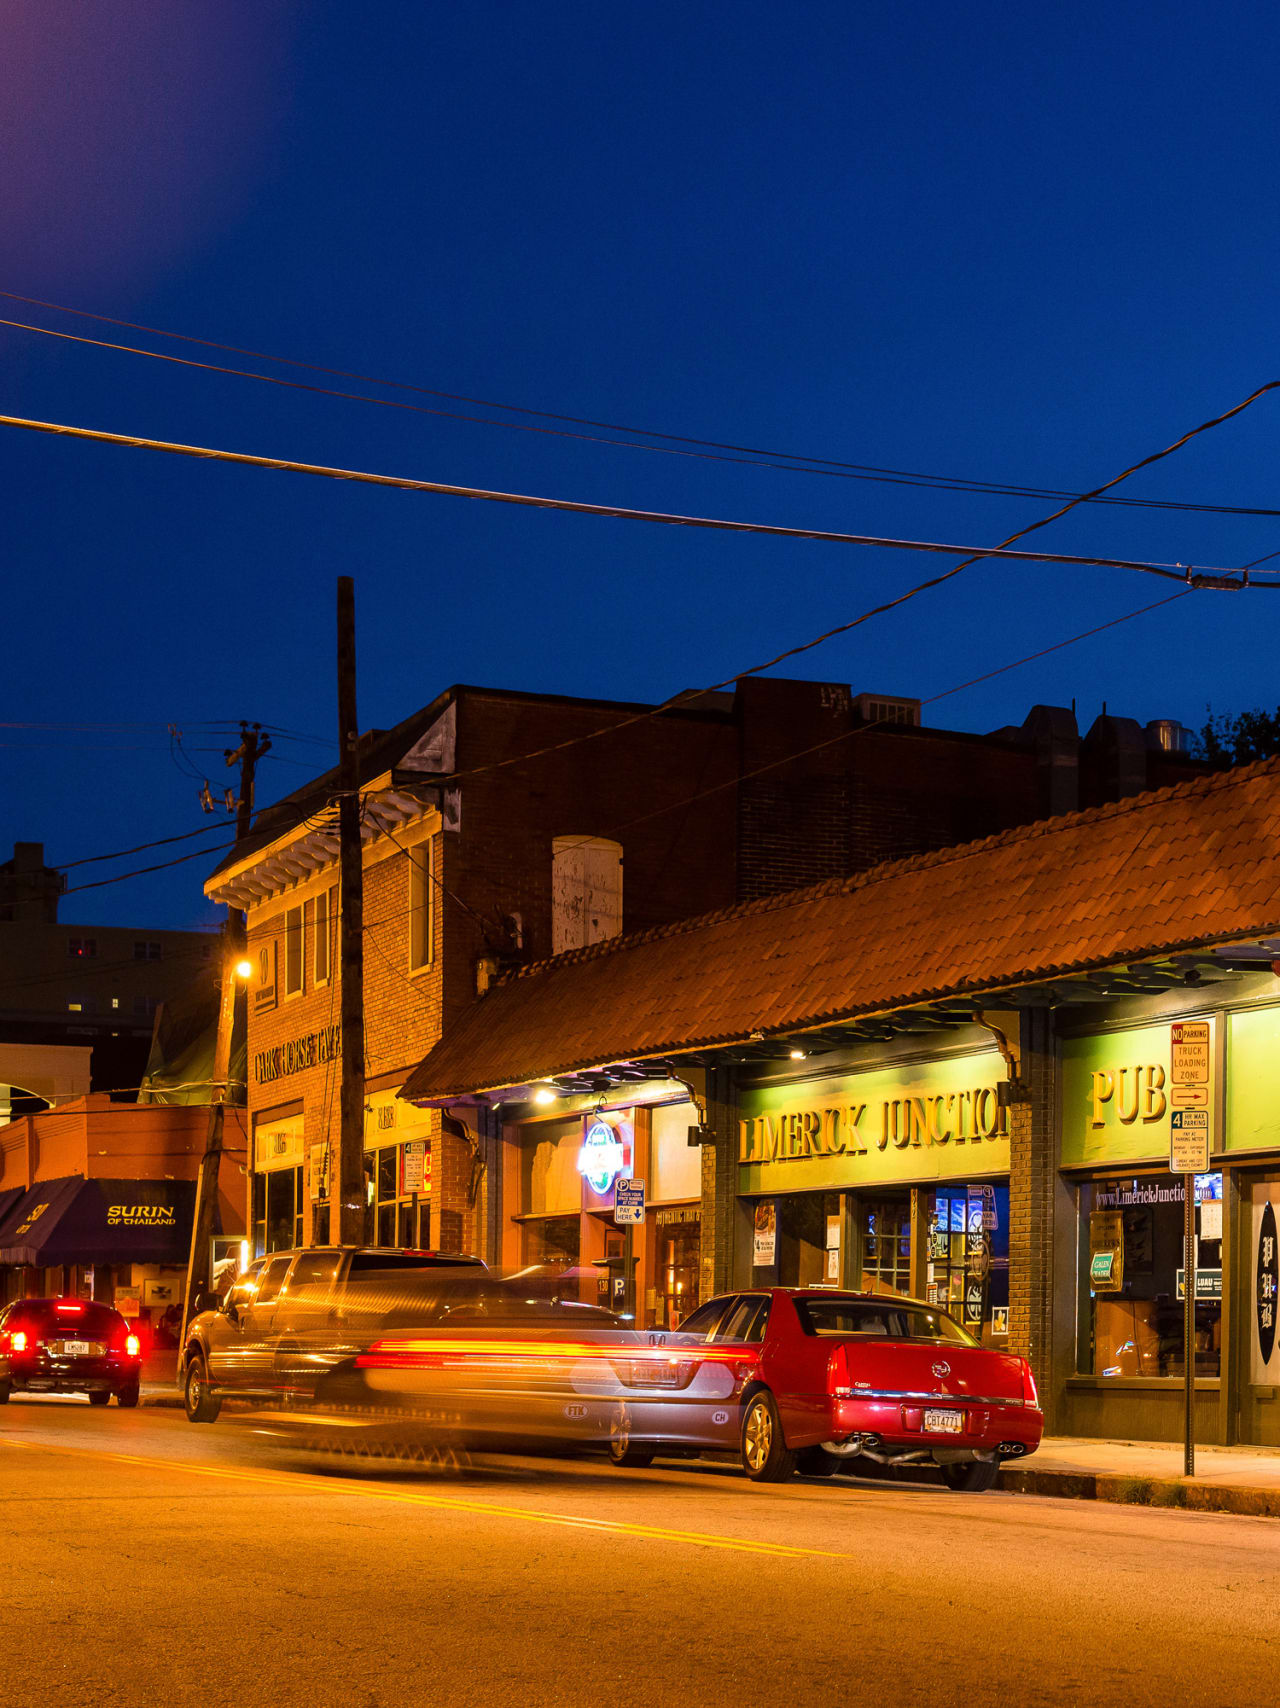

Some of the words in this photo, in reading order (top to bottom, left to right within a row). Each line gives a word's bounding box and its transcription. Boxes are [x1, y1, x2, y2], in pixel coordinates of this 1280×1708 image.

[1173, 1028, 1183, 1040] NO
[1184, 1029, 1206, 1039] PARKING
[1178, 1047, 1202, 1055] TRUCK
[255, 1047, 279, 1084] DARK
[281, 1034, 314, 1077] HORSE
[1174, 1059, 1206, 1067] LOADING
[1180, 1071, 1199, 1079] ZONE
[1090, 1063, 1167, 1128] PUB
[1173, 1113, 1181, 1127] 4
[738, 1104, 868, 1164] LIMERICK
[620, 1181, 626, 1190] P
[1096, 1182, 1212, 1205] www.LimerickJunctiocom
[107, 1205, 174, 1217] SURIN
[598, 1280, 609, 1292] 130
[614, 1280, 625, 1296] P
[1197, 1278, 1213, 1286] LUAU
[568, 1406, 584, 1416] FTK
[715, 1413, 725, 1422] CH
[926, 1415, 958, 1426] CBT4771
